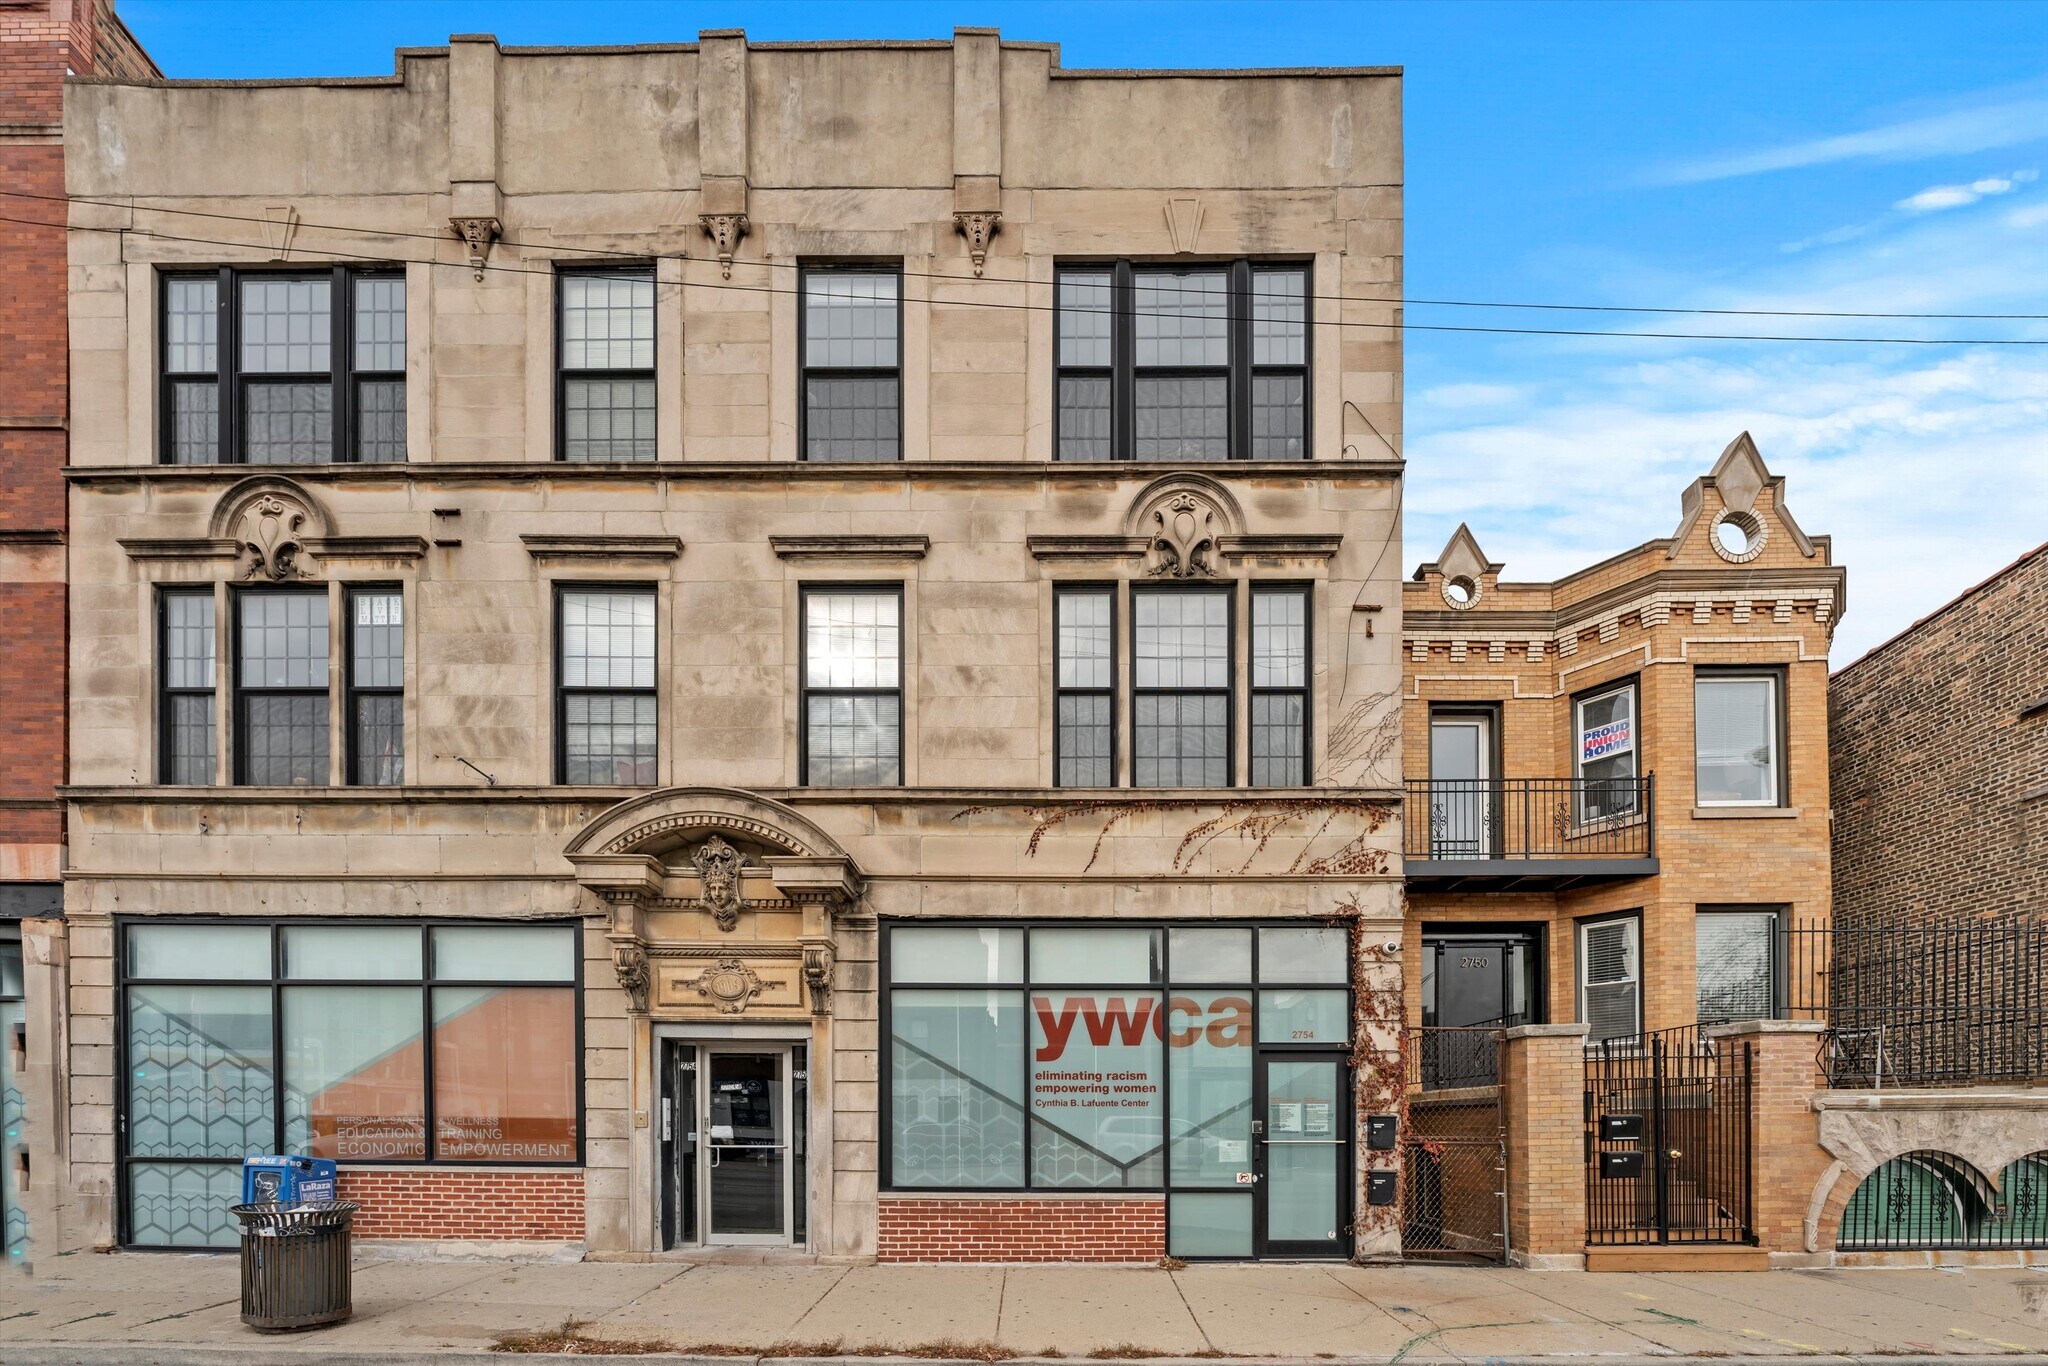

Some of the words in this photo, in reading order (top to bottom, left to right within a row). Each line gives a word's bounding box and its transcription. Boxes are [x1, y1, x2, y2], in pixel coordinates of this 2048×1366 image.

[359, 598, 400, 606] BAK
[359, 606, 400, 614] LVS
[1583, 721, 1630, 741] PROUD
[1583, 729, 1630, 750] UNION
[1460, 957, 1489, 968] 2750
[1032, 996, 1252, 1062] ywca
[1292, 1030, 1314, 1039] 2754
[1034, 1071, 1103, 1082] eliminating
[1106, 1071, 1148, 1080] racism
[1034, 1083, 1110, 1094] empowering
[1113, 1085, 1157, 1093] women
[1035, 1099, 1068, 1108] Cynthia
[1081, 1099, 1119, 1107] Lafuente
[1121, 1099, 1150, 1107] Center
[336, 1116, 388, 1125] PERSONAL
[447, 1117, 499, 1126] WELLNESS
[337, 1127, 414, 1139] EDUCATION
[418, 1128, 425, 1139] &
[440, 1128, 503, 1140] TRAINING
[337, 1141, 426, 1155] ECONOMIC
[439, 1143, 570, 1156] EMPOWERMENT
[301, 1182, 331, 1192] LaRaza
